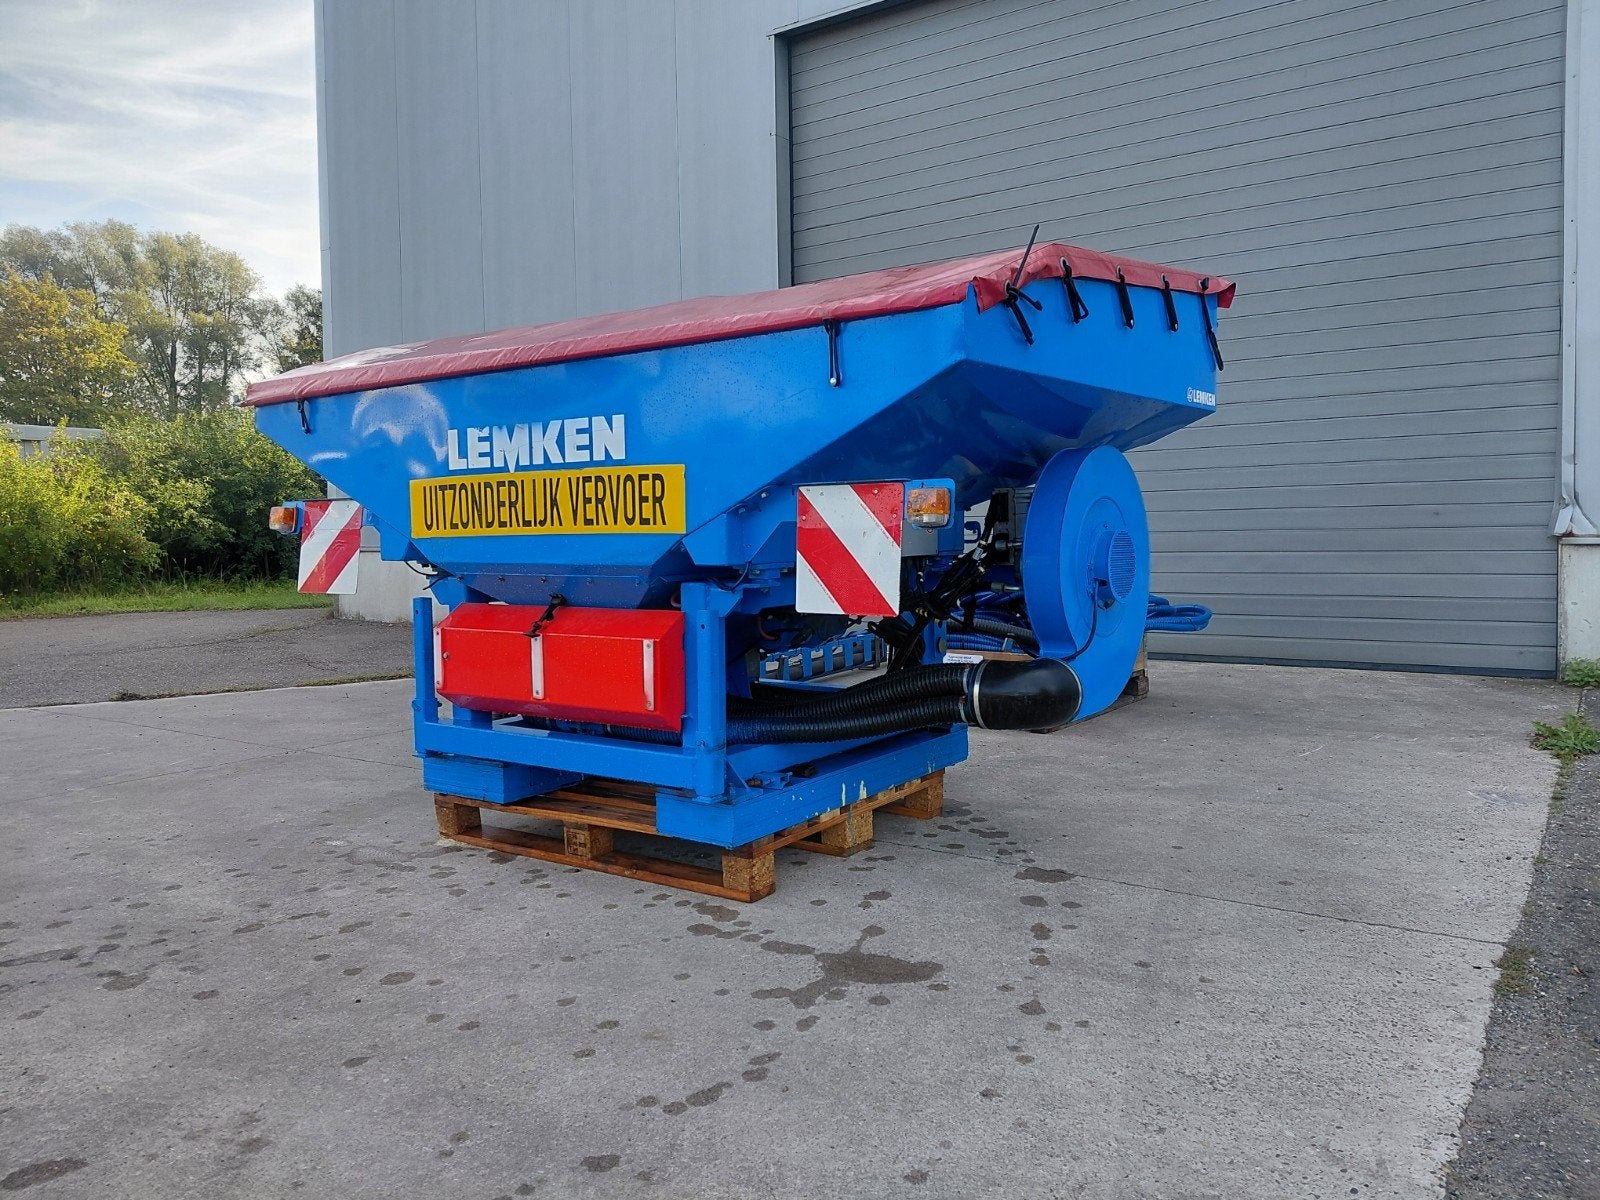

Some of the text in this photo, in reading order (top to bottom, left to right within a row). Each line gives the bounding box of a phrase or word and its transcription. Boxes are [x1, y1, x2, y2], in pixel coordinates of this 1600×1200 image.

[1193, 389, 1216, 407] LEMKEN
[448, 414, 625, 473] LEMKEN
[423, 473, 667, 531] UITZONDERLIJK VERVOER
